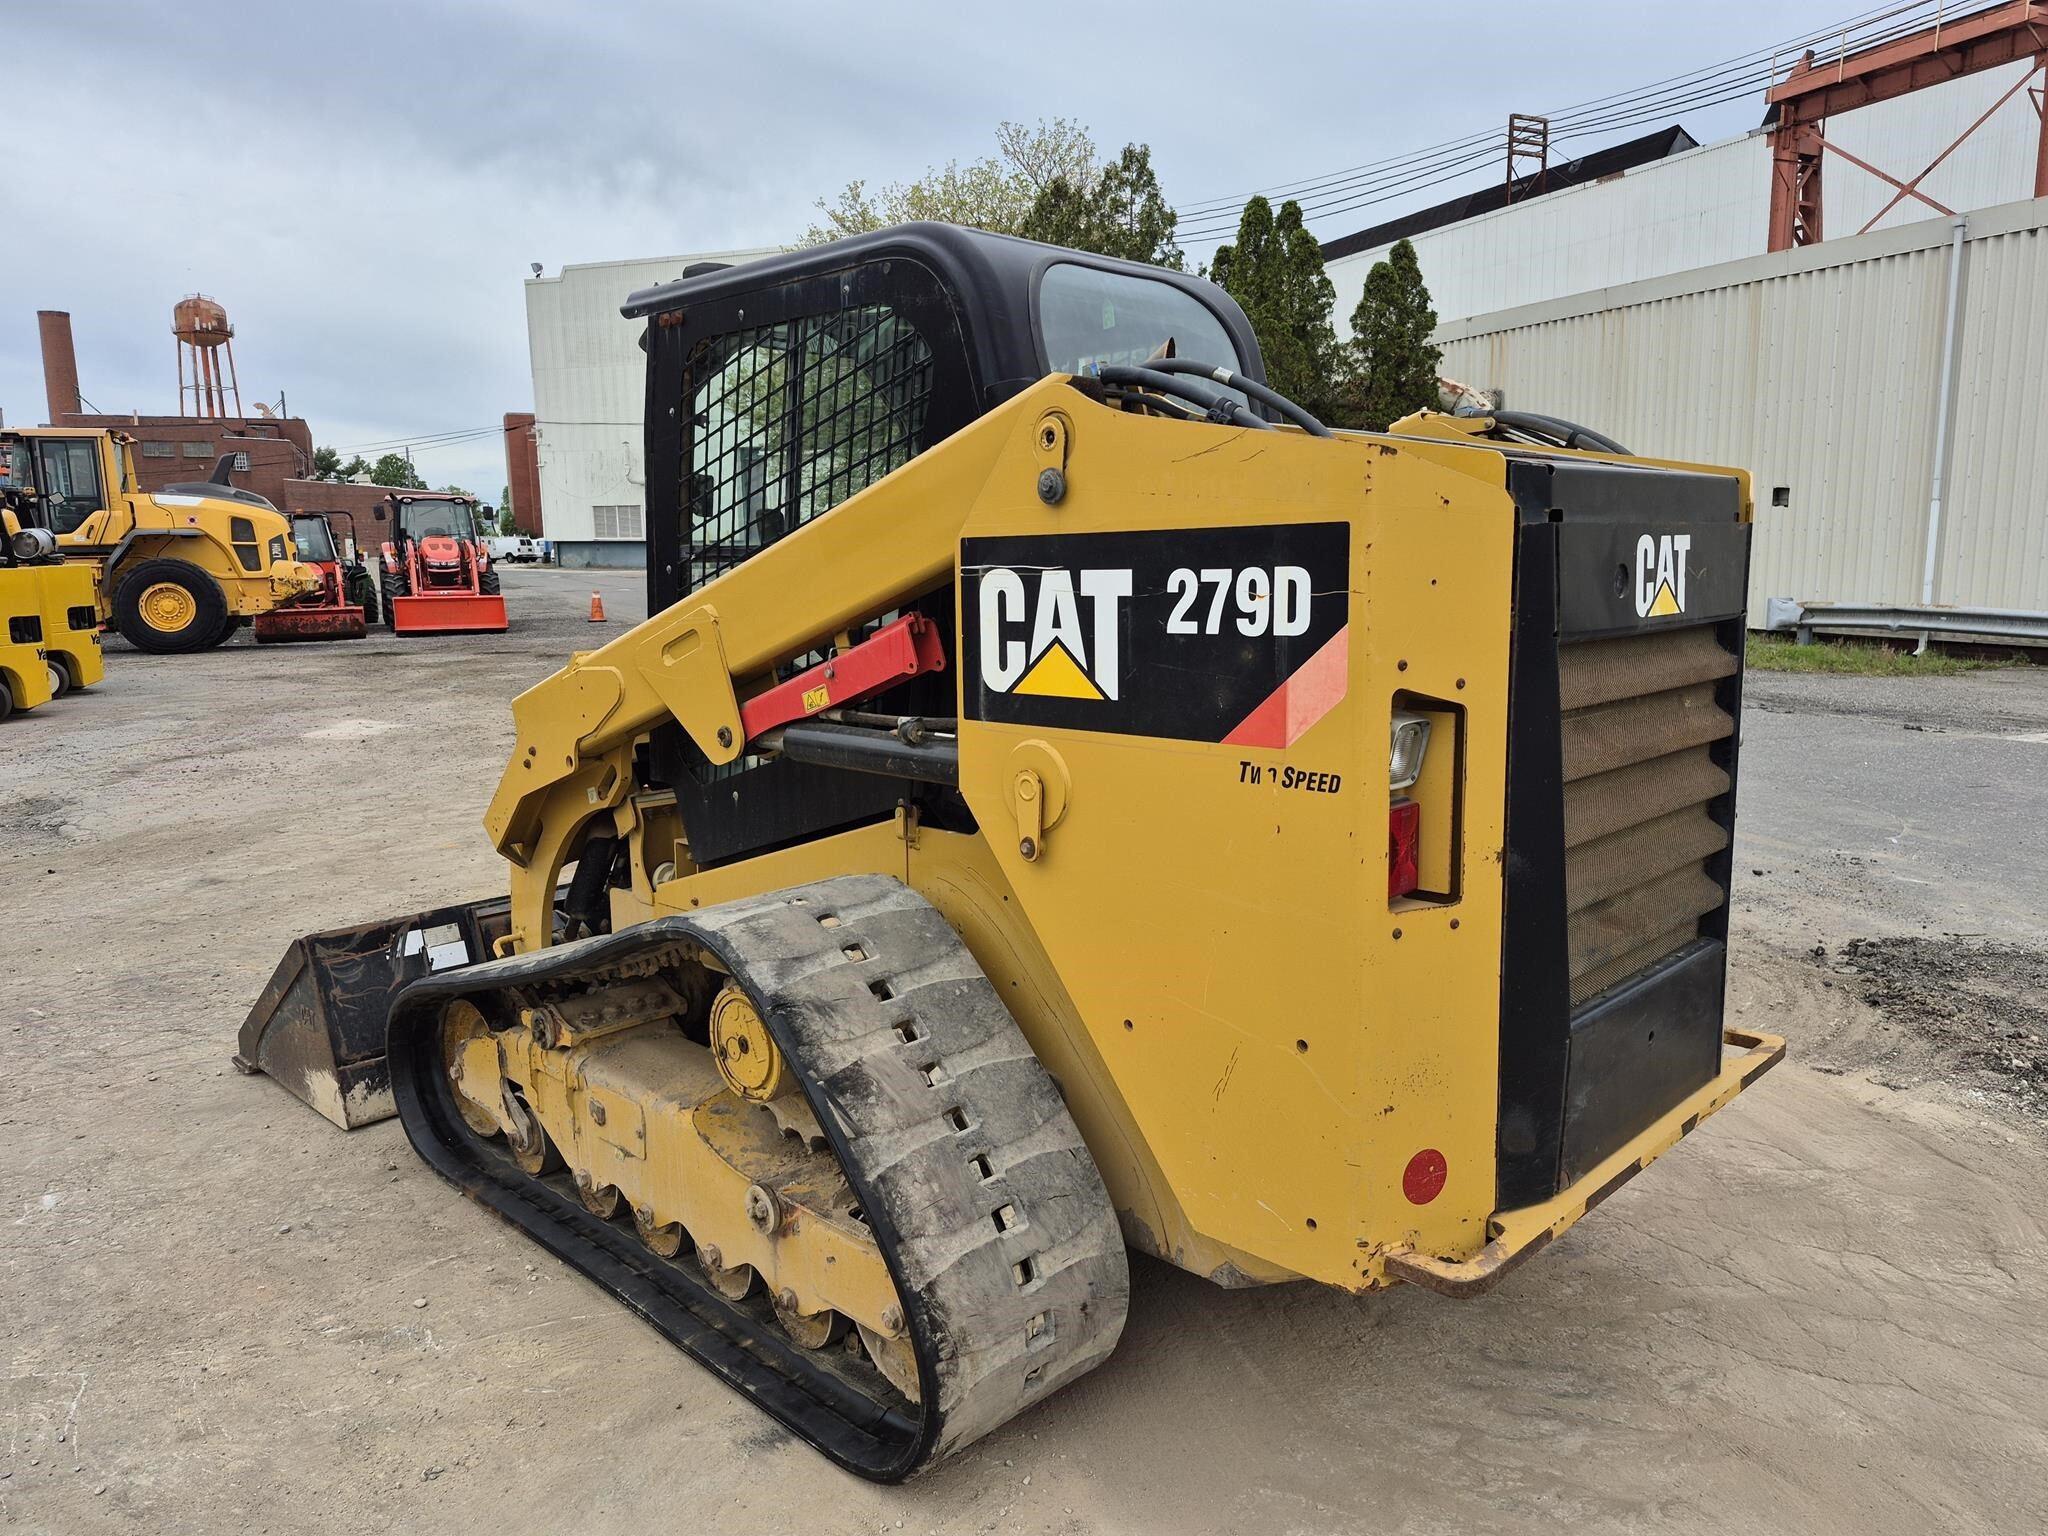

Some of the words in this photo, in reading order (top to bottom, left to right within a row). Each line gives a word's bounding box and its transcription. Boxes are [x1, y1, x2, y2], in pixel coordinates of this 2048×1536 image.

[1635, 534, 1690, 618] CAT
[979, 568, 1133, 701] CAT
[1166, 566, 1311, 637] 279D
[1281, 766, 1341, 793] SPEED
